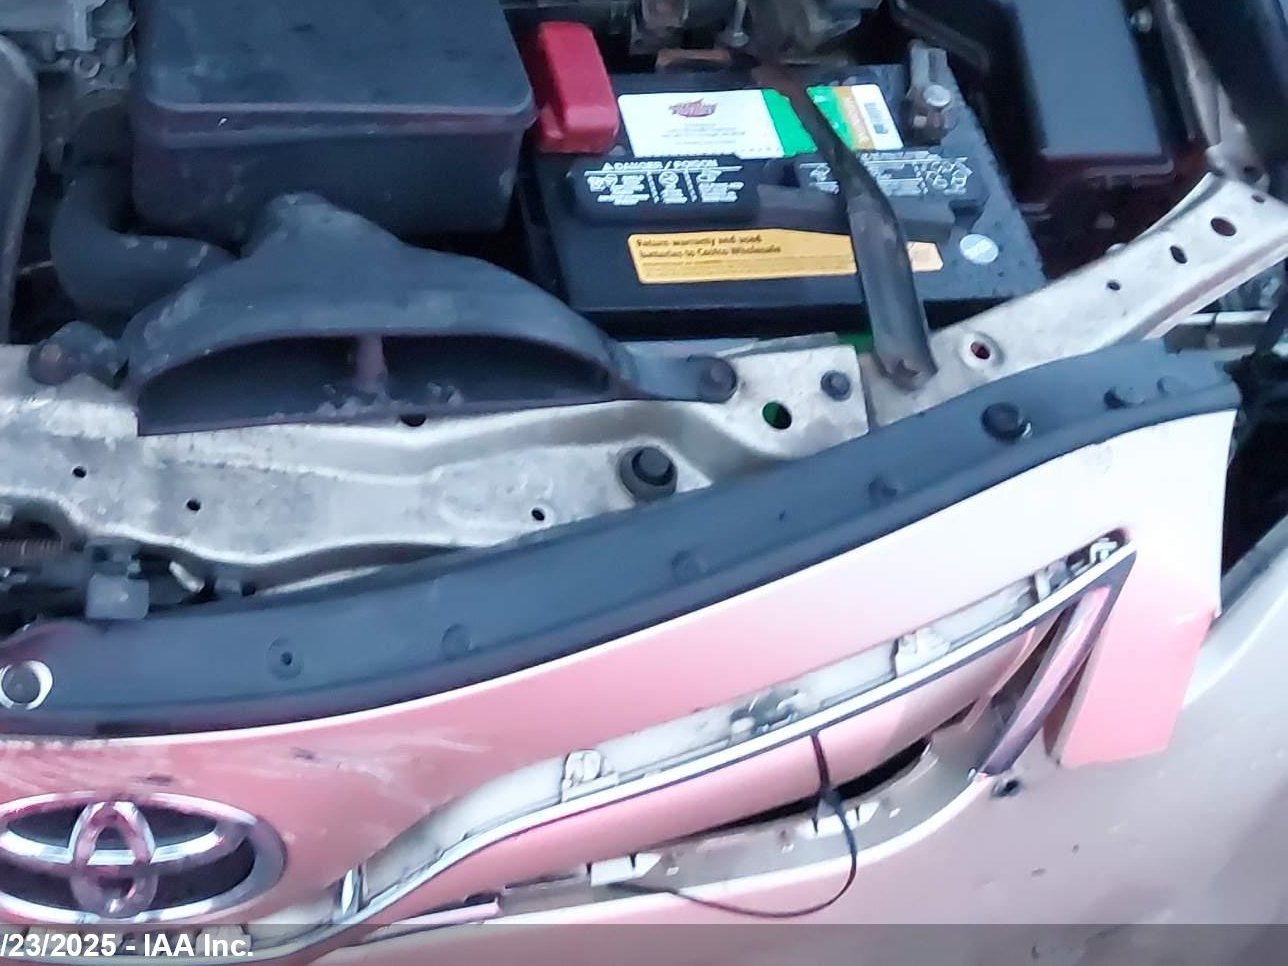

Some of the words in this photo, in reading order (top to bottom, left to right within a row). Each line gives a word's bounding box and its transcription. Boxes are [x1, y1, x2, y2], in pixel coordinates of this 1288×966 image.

[614, 161, 663, 171] DANGER
[673, 159, 719, 169] POISON
[636, 238, 669, 247] Return
[673, 236, 715, 247] warranty
[718, 234, 736, 244] and
[739, 234, 762, 243] used
[731, 245, 781, 254] Wholesale
